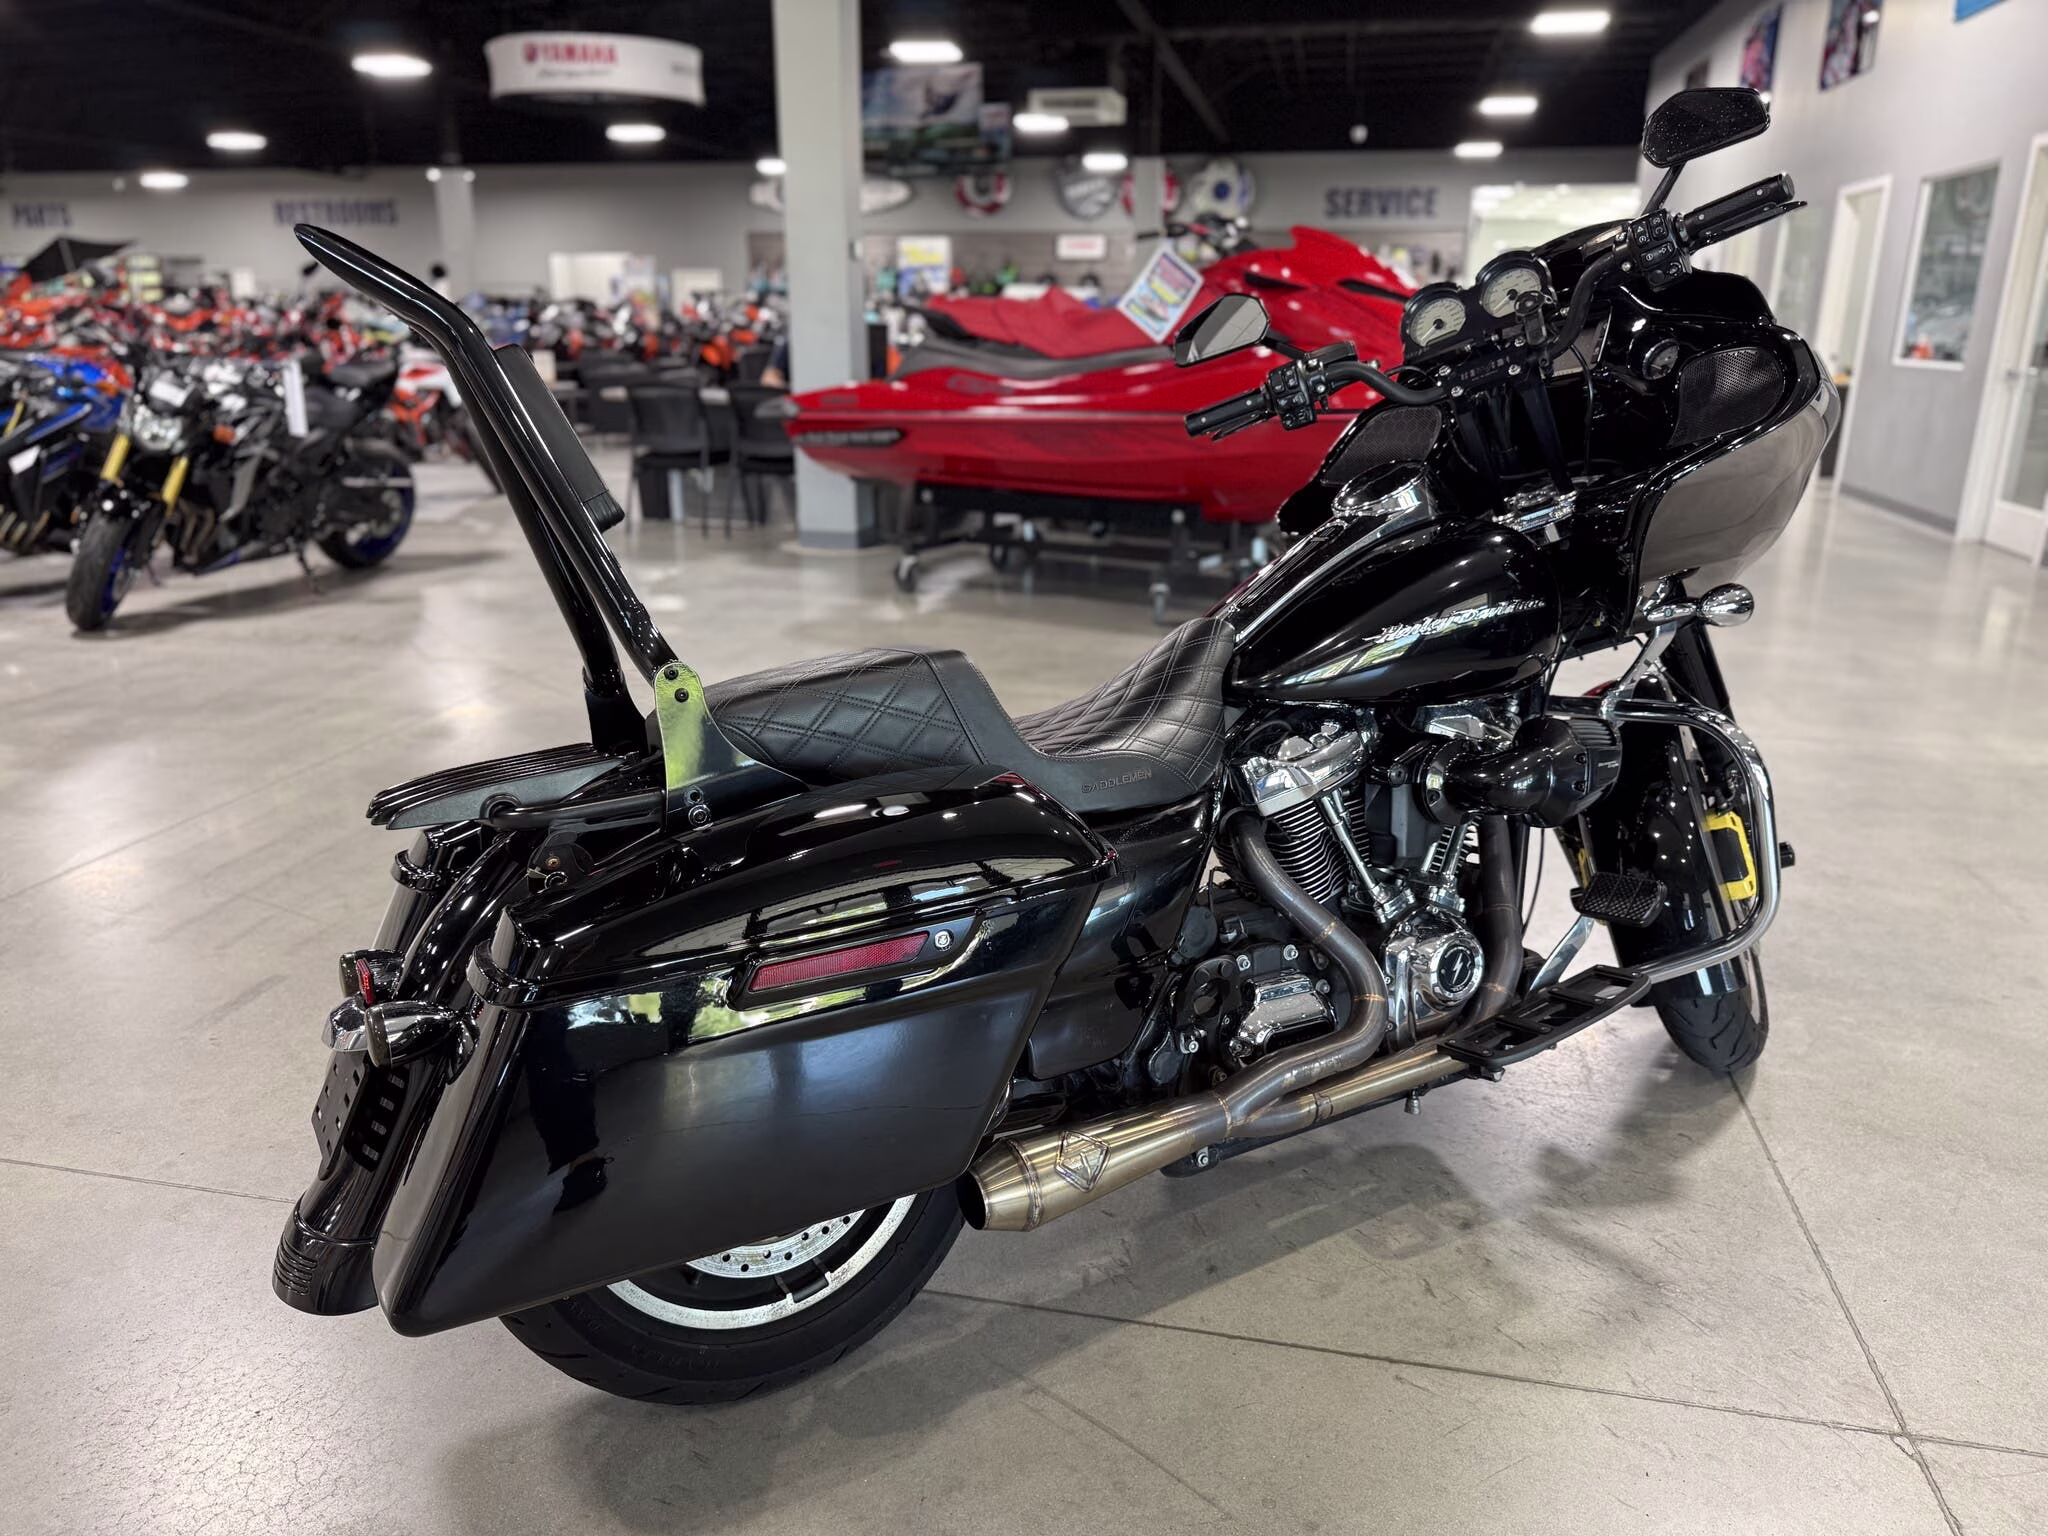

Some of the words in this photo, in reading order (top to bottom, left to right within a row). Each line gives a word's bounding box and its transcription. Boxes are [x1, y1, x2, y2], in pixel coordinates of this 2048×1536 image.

[540, 42, 619, 64] YAMAHA
[12, 202, 72, 227] PARTS
[275, 199, 399, 226] RESTROOMS
[1325, 187, 1438, 218] SERVICE
[1081, 767, 1153, 794] SADDLEMEN
